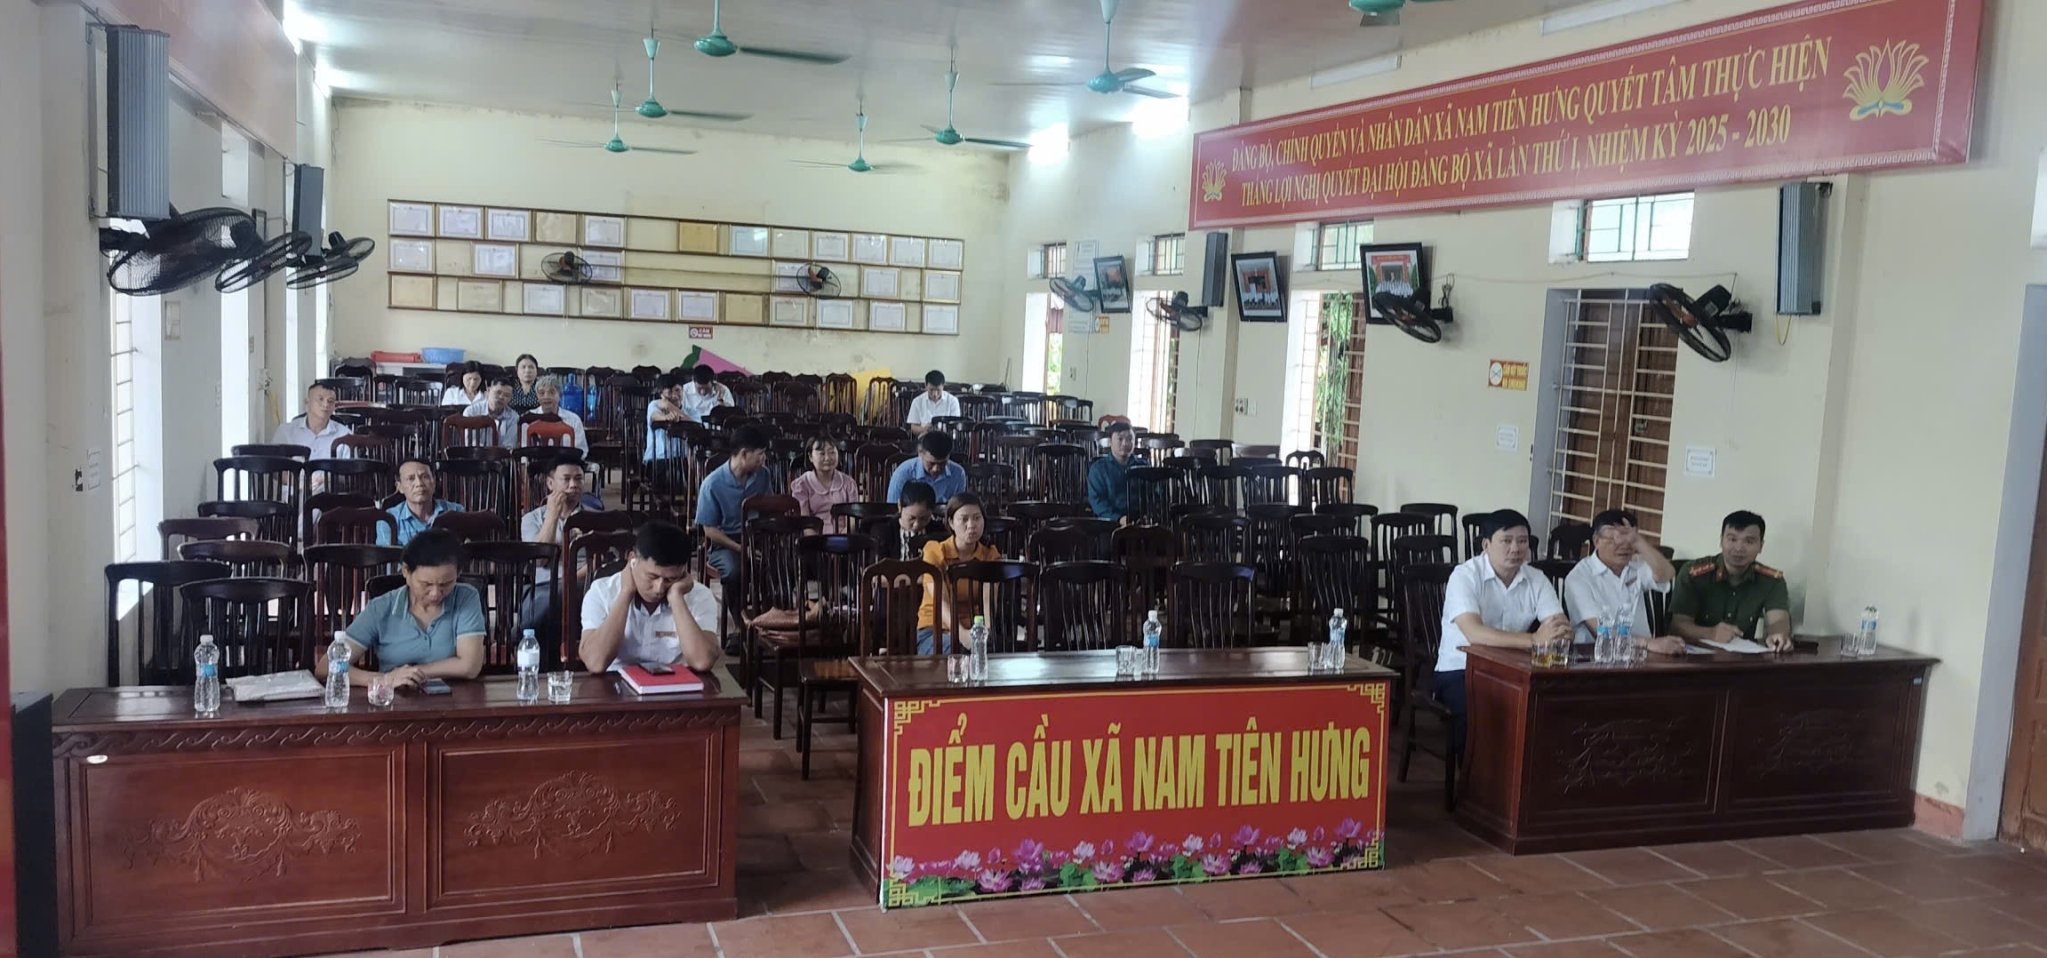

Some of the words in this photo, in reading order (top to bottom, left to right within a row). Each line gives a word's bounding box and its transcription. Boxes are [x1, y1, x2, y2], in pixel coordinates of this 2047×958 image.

[1274, 176, 1293, 208] LỢI
[1293, 173, 1321, 207] NGHỊ
[1322, 161, 1361, 204] QUYẾT
[1362, 165, 1383, 200] ĐẠI
[1385, 157, 1409, 198] HỘI
[1410, 149, 1449, 189] ĐẢNG
[1450, 148, 1471, 191] BỘ
[1473, 142, 1493, 181] XÃ
[1532, 128, 1570, 175] THỨ
[1585, 123, 1649, 173] NHIỆM
[1652, 110, 1684, 161] KỲ
[1685, 113, 1729, 156] 2025
[1732, 131, 1740, 140] -
[1744, 104, 1791, 149] 2030
[1276, 130, 1309, 166] CHÍNH
[1350, 118, 1365, 155] VÀ
[1367, 111, 1403, 153] NHÂN
[1403, 106, 1432, 146] DÂN
[1433, 102, 1453, 142] XÃ
[1455, 103, 1489, 138] NAM
[1492, 88, 1528, 132] TIÊN
[1530, 85, 1581, 128] HƯNG
[1584, 65, 1648, 125] QUYẾT
[1652, 55, 1698, 106] TÂM
[1702, 45, 1766, 102] THỰC
[1769, 34, 1832, 92] HIỆN
[908, 712, 995, 827] ĐIỂM
[1006, 713, 1072, 820] CẦU
[1080, 722, 1124, 814] XÃ
[1133, 734, 1206, 811] NAM
[1215, 716, 1283, 807] TIÊN
[1290, 721, 1372, 803] HƯNG
